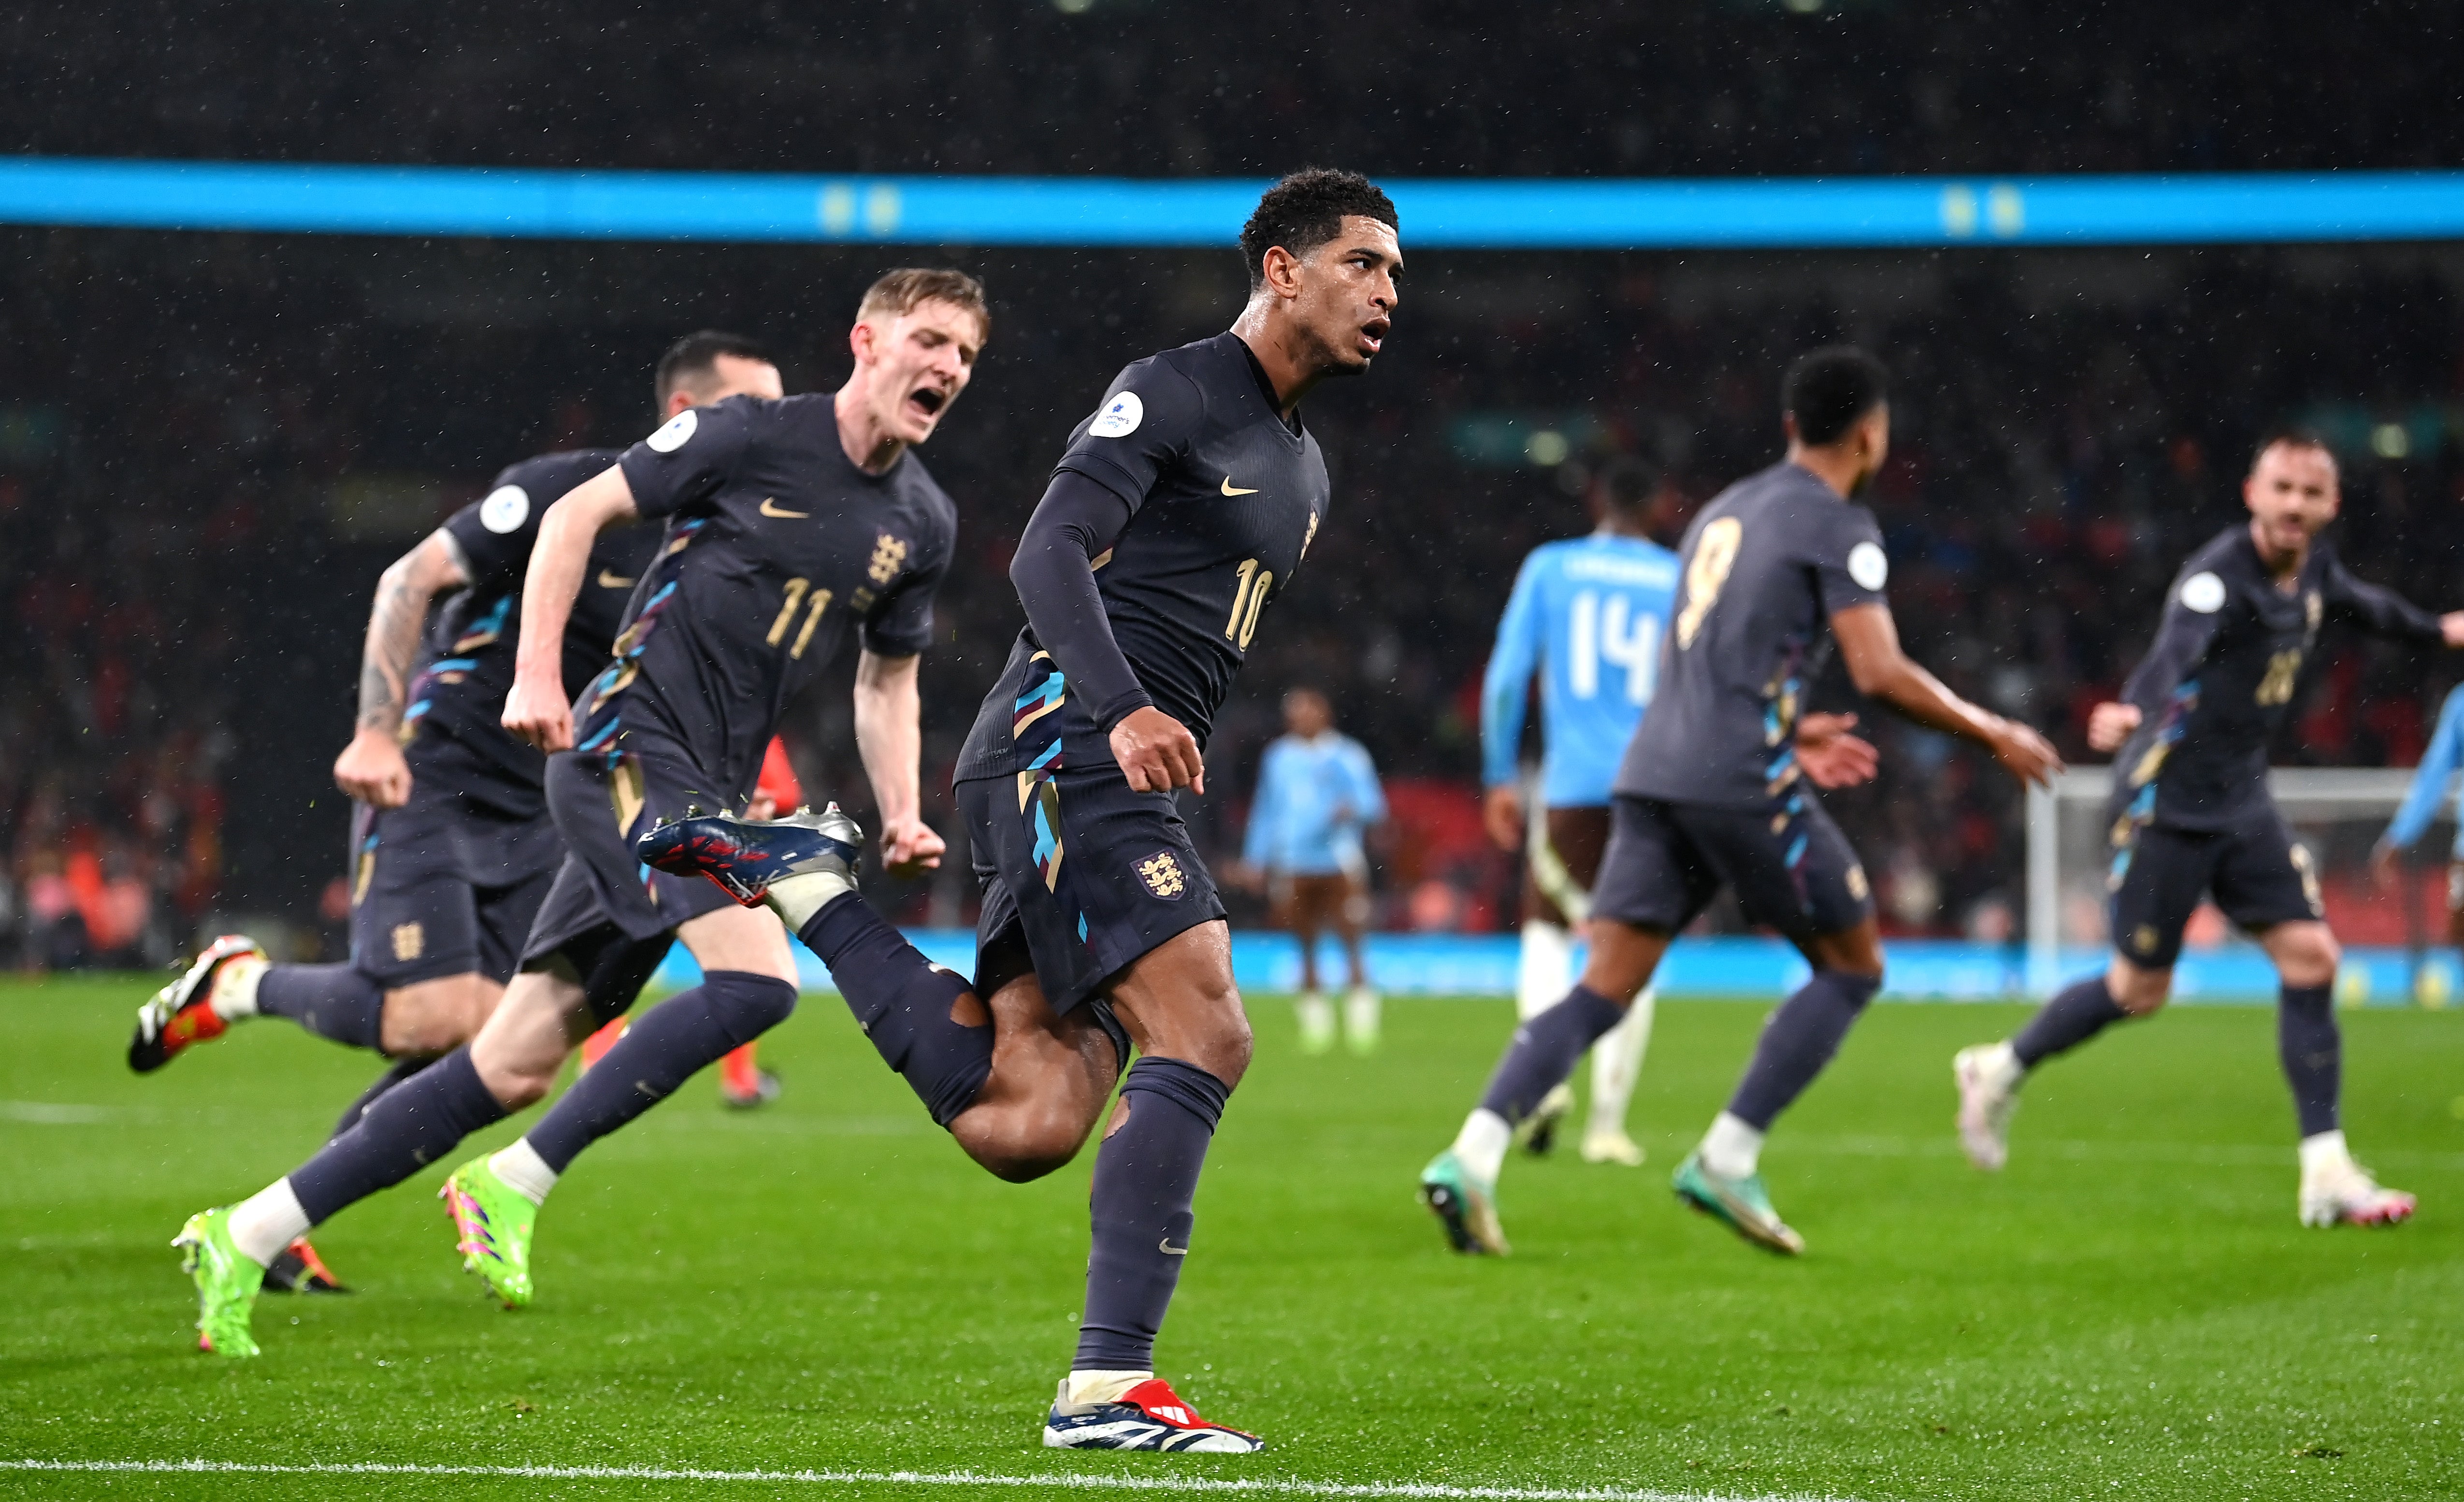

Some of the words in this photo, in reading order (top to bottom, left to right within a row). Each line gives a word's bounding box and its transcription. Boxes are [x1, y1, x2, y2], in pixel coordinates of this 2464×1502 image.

[766, 577, 834, 660] 11
[1225, 558, 1273, 652] 10
[1569, 589, 1659, 708] 14
